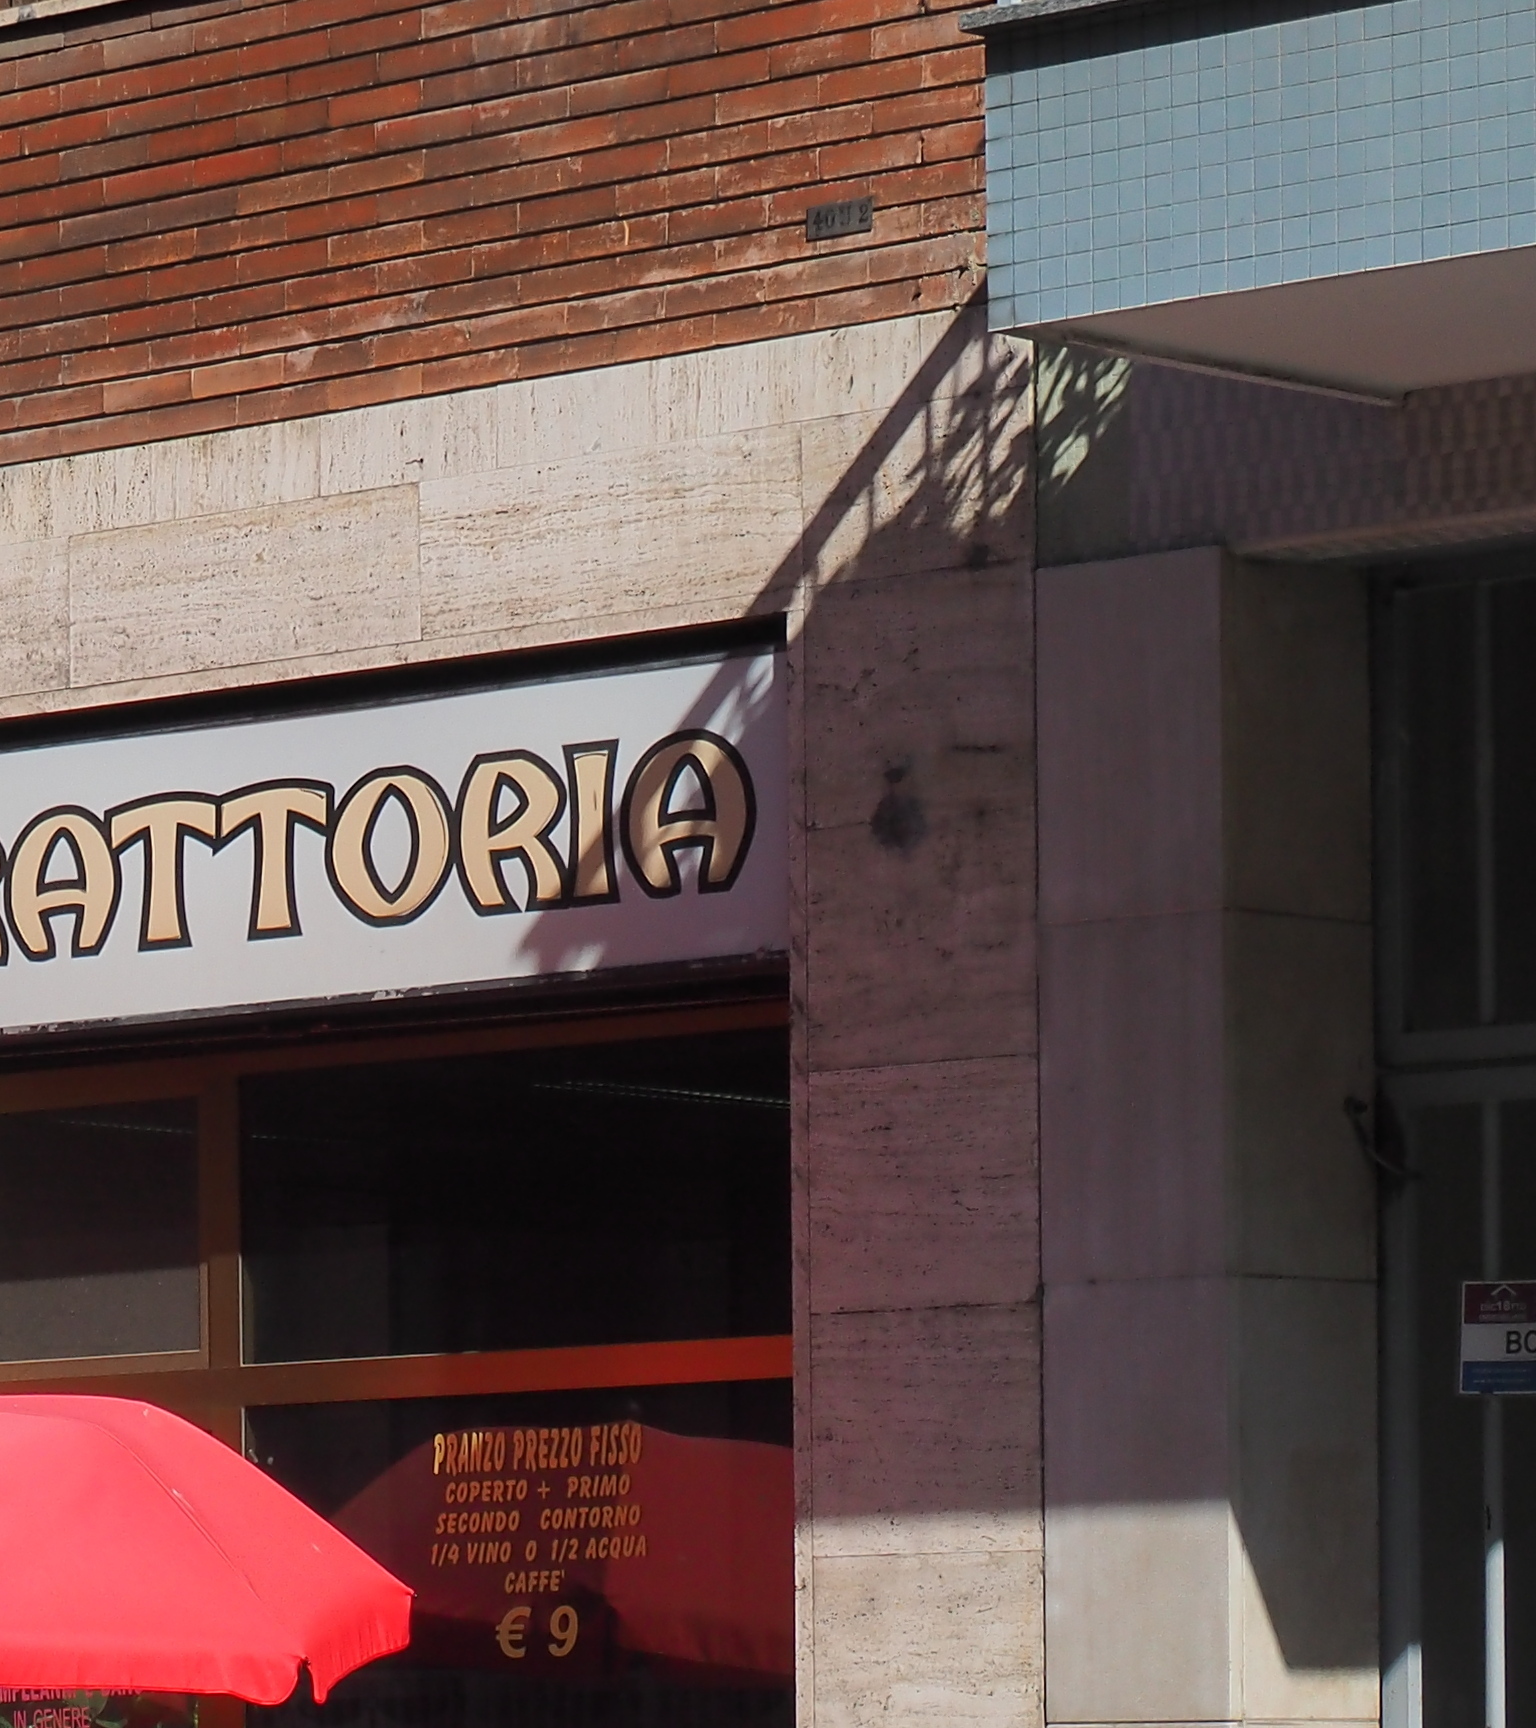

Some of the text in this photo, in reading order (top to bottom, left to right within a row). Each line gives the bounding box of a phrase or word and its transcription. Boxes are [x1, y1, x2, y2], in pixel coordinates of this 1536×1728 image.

[432, 1423, 643, 1475] PRANZO PREZZO FISSO
[445, 1481, 528, 1503] COPERTO
[566, 1474, 631, 1499] PRIMO
[435, 1505, 642, 1535] SECONDO CONTORNO
[430, 1534, 648, 1566] 1/4 VINO O 1/2 ACQUA
[496, 1605, 578, 1659] € 9
